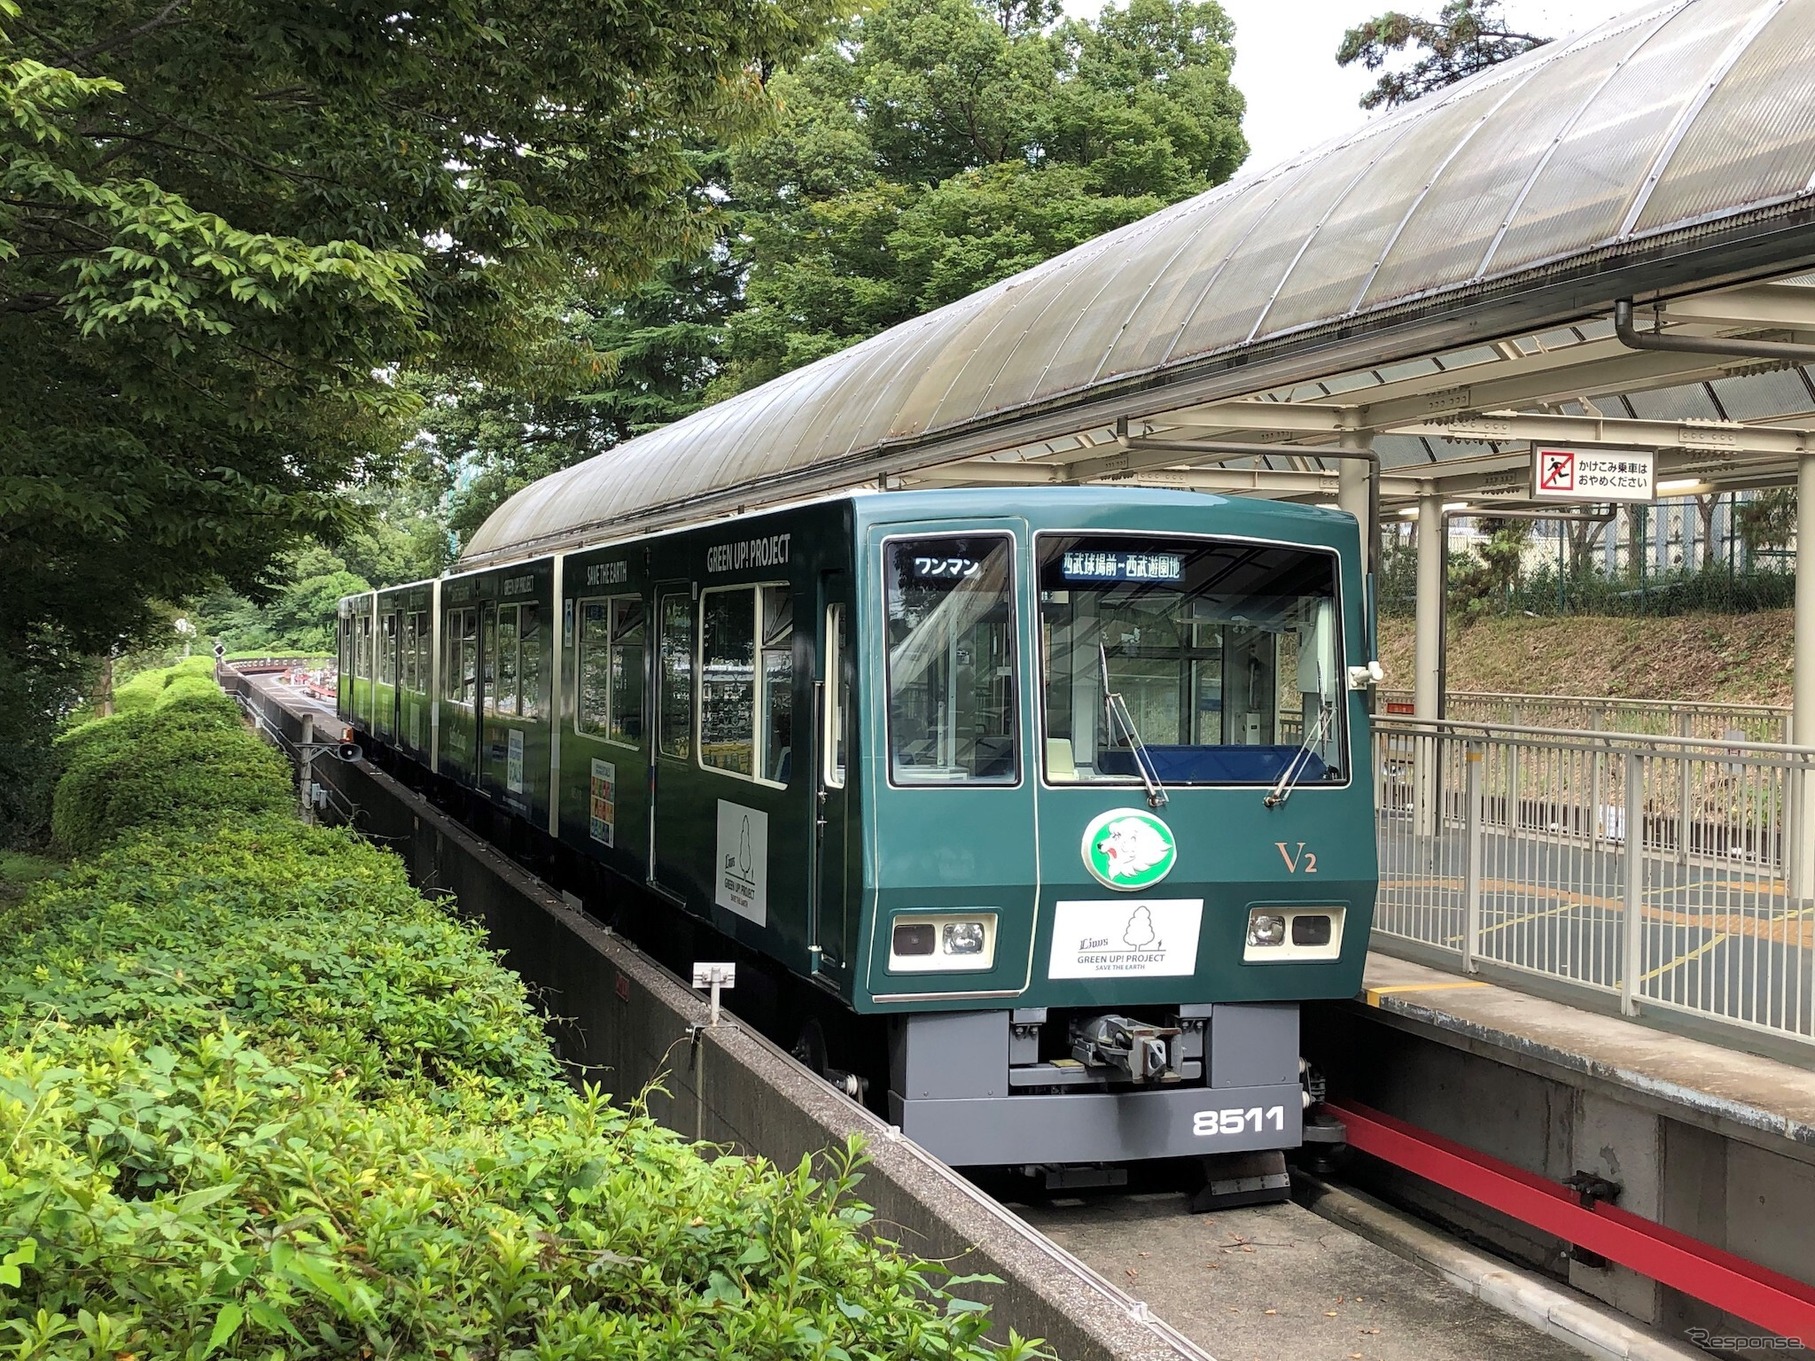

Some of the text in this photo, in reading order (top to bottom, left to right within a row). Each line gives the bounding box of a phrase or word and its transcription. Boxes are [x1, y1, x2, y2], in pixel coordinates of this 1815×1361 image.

[1578, 460, 1648, 474] かけこみ乗車は
[1578, 475, 1648, 488] おやめください
[707, 533, 791, 573] GREEN UP! PROJECT
[915, 557, 979, 575] ワンマン
[1274, 842, 1318, 874] V2
[1077, 954, 1166, 964] GREEN UP! PROJECT
[1193, 1105, 1284, 1136] 8511
